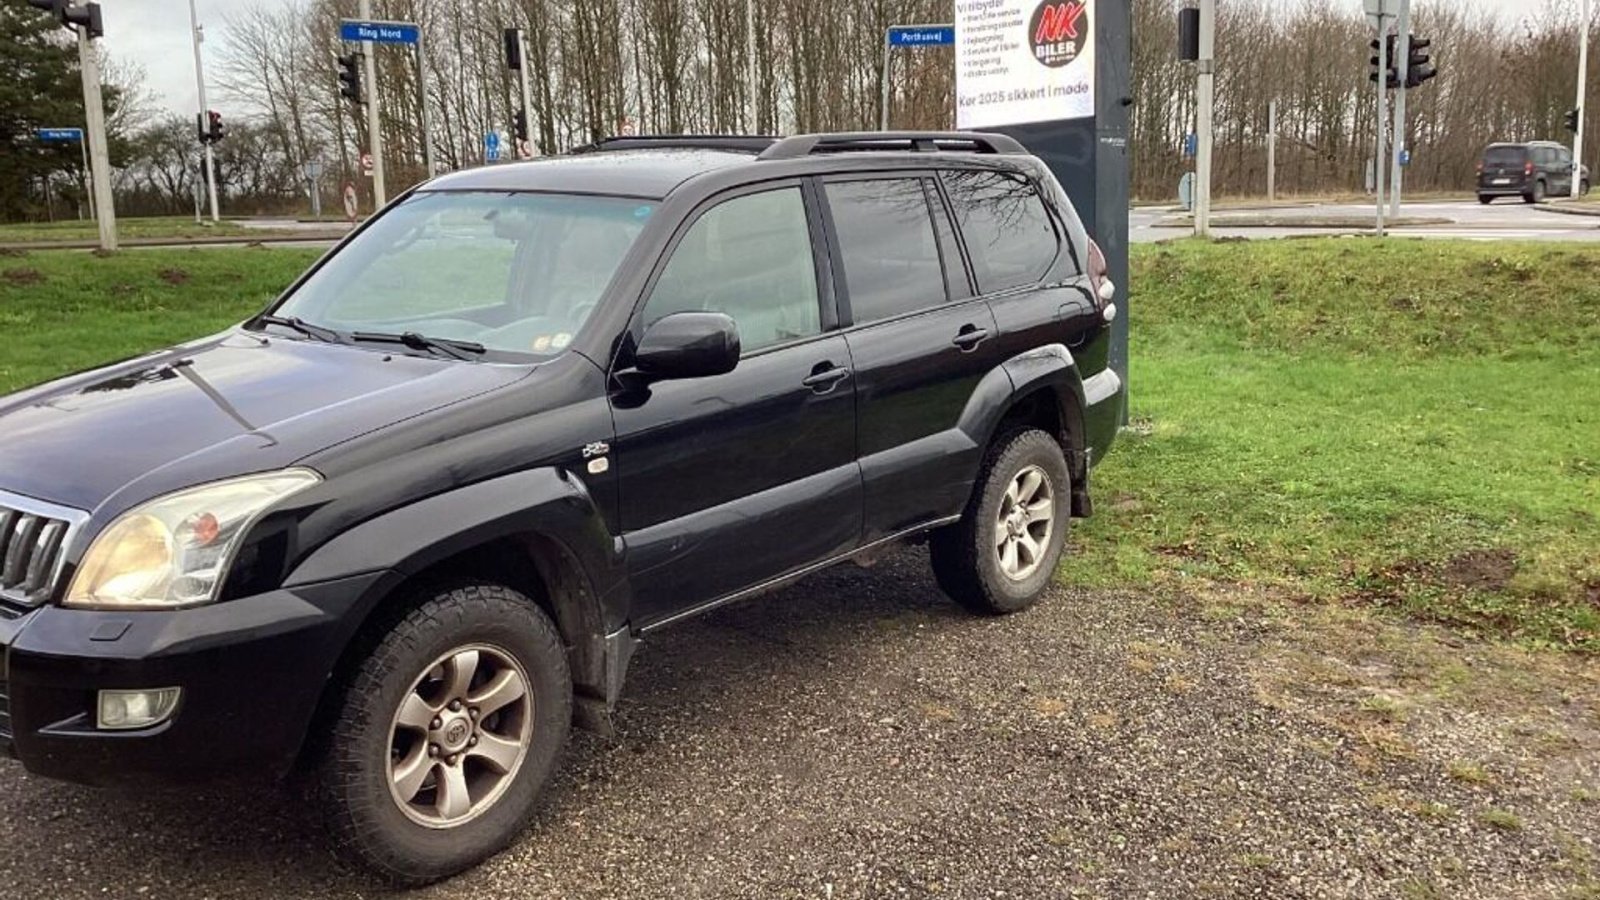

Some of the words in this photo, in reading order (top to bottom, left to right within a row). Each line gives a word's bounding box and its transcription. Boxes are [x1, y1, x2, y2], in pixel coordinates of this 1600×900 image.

[358, 27, 378, 39] Ring
[380, 28, 402, 39] Nord
[1035, 1, 1086, 44] NK
[1035, 41, 1076, 58] BILER
[978, 91, 1006, 105] 2025
[1007, 86, 1046, 102] sikkert
[1053, 80, 1089, 97] møde
